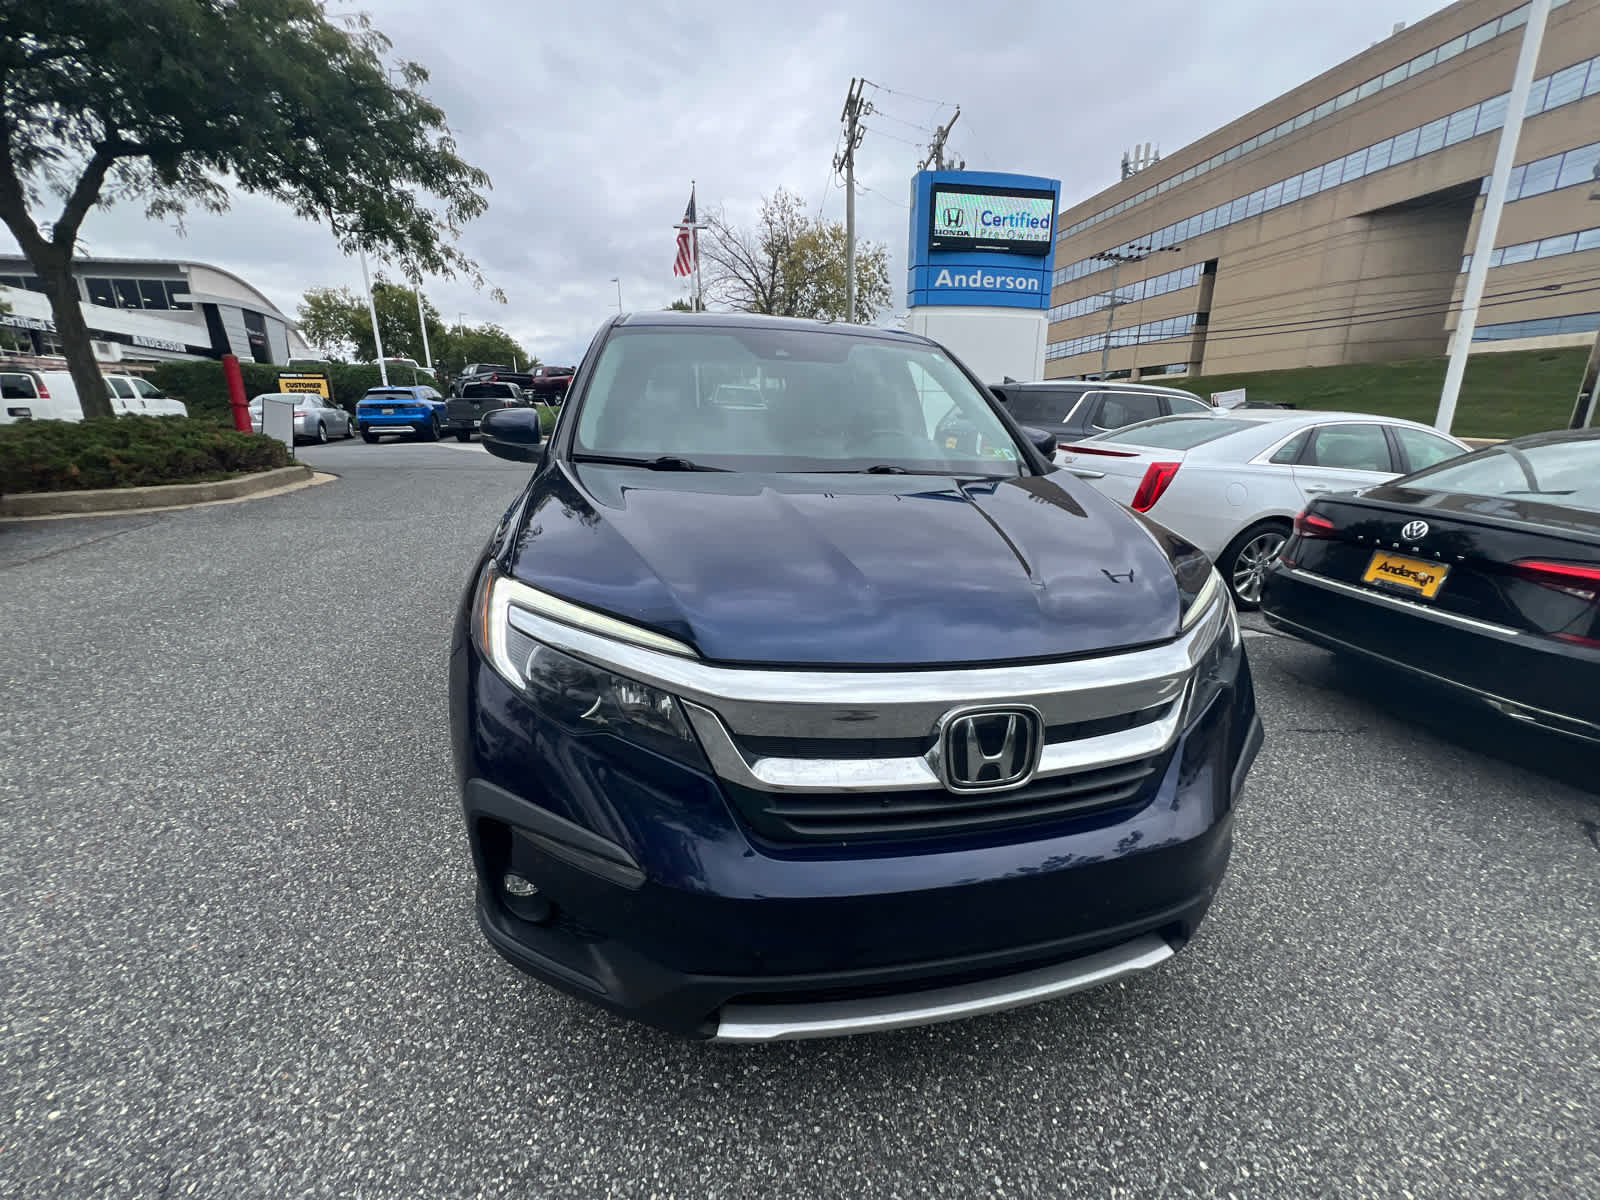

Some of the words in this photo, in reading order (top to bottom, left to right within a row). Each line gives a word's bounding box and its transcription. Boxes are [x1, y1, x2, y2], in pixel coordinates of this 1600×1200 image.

[981, 210, 1050, 229] Certified
[933, 229, 970, 237] HONDA
[980, 228, 1049, 241] Pre-Owned
[934, 269, 1039, 291] Anderson
